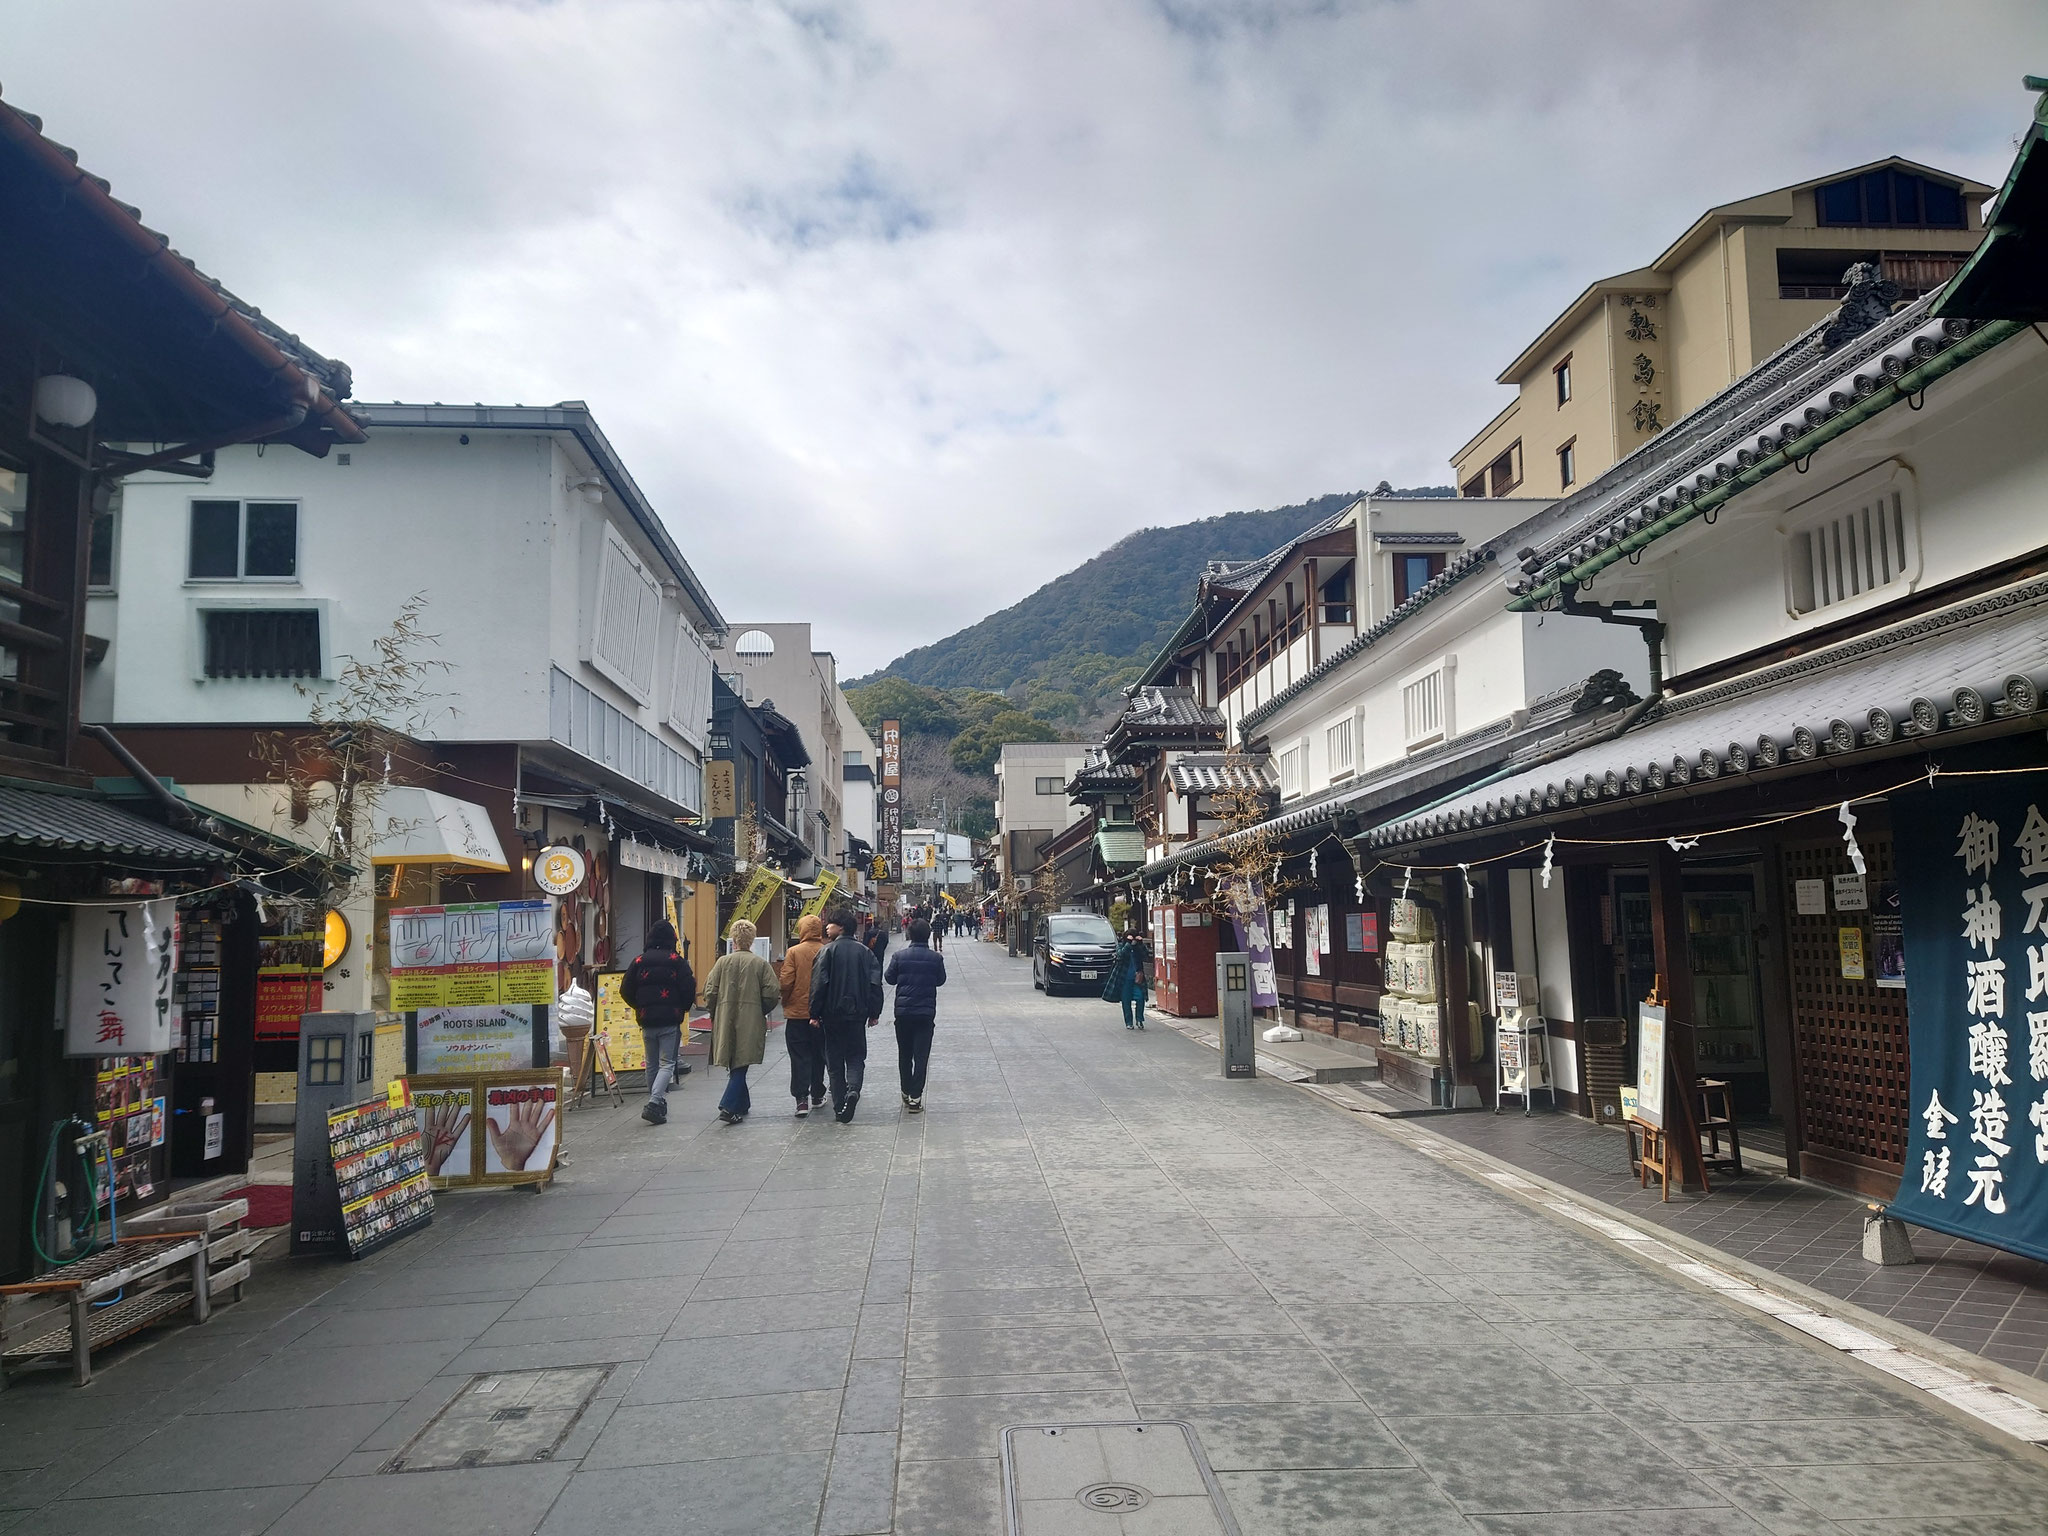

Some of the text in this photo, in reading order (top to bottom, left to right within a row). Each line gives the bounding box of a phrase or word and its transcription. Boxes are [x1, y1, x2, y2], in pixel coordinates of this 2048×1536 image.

[884, 728, 899, 777] 中野屋
[1842, 941, 1860, 949] 加盟店
[443, 1018, 507, 1029] ROOTS ISLAND
[488, 1087, 557, 1105] 最凶の手相
